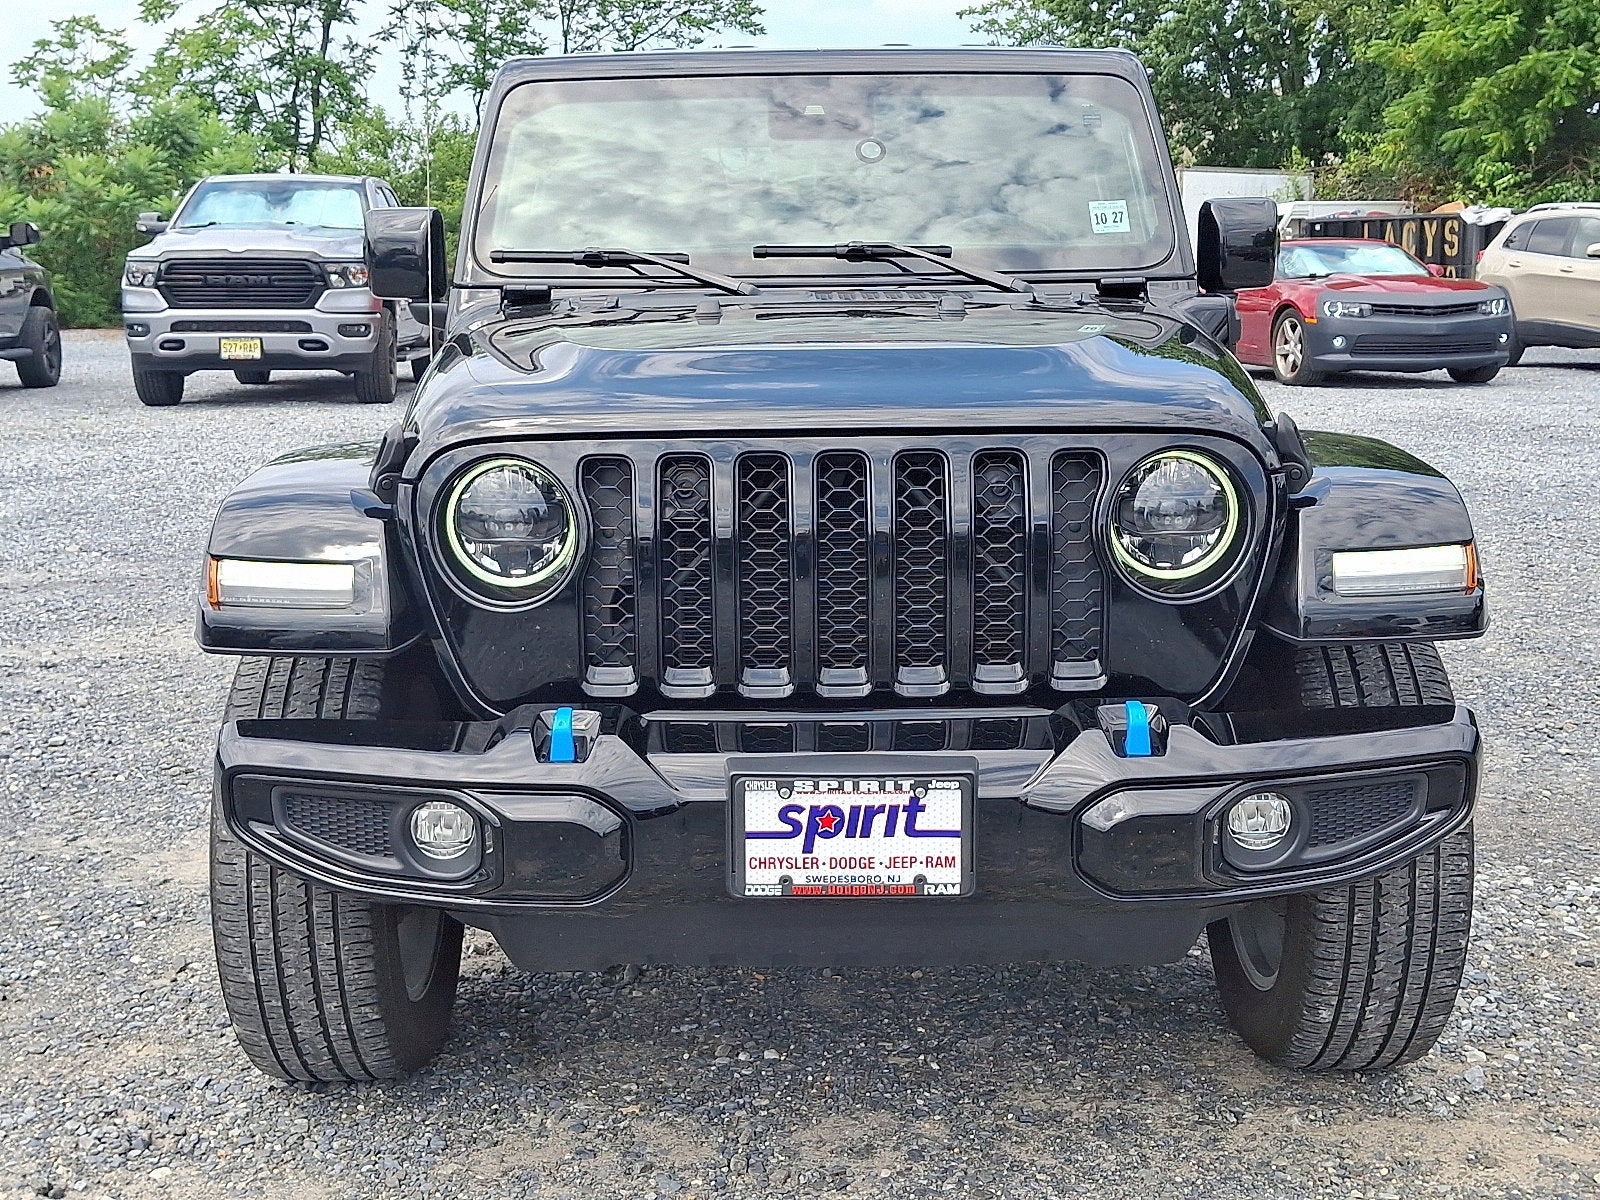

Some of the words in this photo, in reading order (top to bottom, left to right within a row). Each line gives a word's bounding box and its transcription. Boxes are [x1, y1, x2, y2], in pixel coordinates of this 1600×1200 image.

[1094, 212, 1107, 225] 10
[1112, 211, 1123, 223] 27
[745, 780, 777, 791] CHRYSLER
[793, 780, 914, 792] SPIRIT
[928, 780, 960, 790] Jeep
[778, 796, 926, 854] spirit
[749, 856, 819, 870] CHRYSLER
[829, 856, 876, 870] DODGE
[884, 856, 918, 870] JEEP
[925, 855, 956, 869] RAM
[887, 874, 901, 883] NJ
[745, 884, 783, 896] DODGE
[791, 884, 917, 895] www.DodgeNJ.com
[923, 883, 961, 895] RAM
